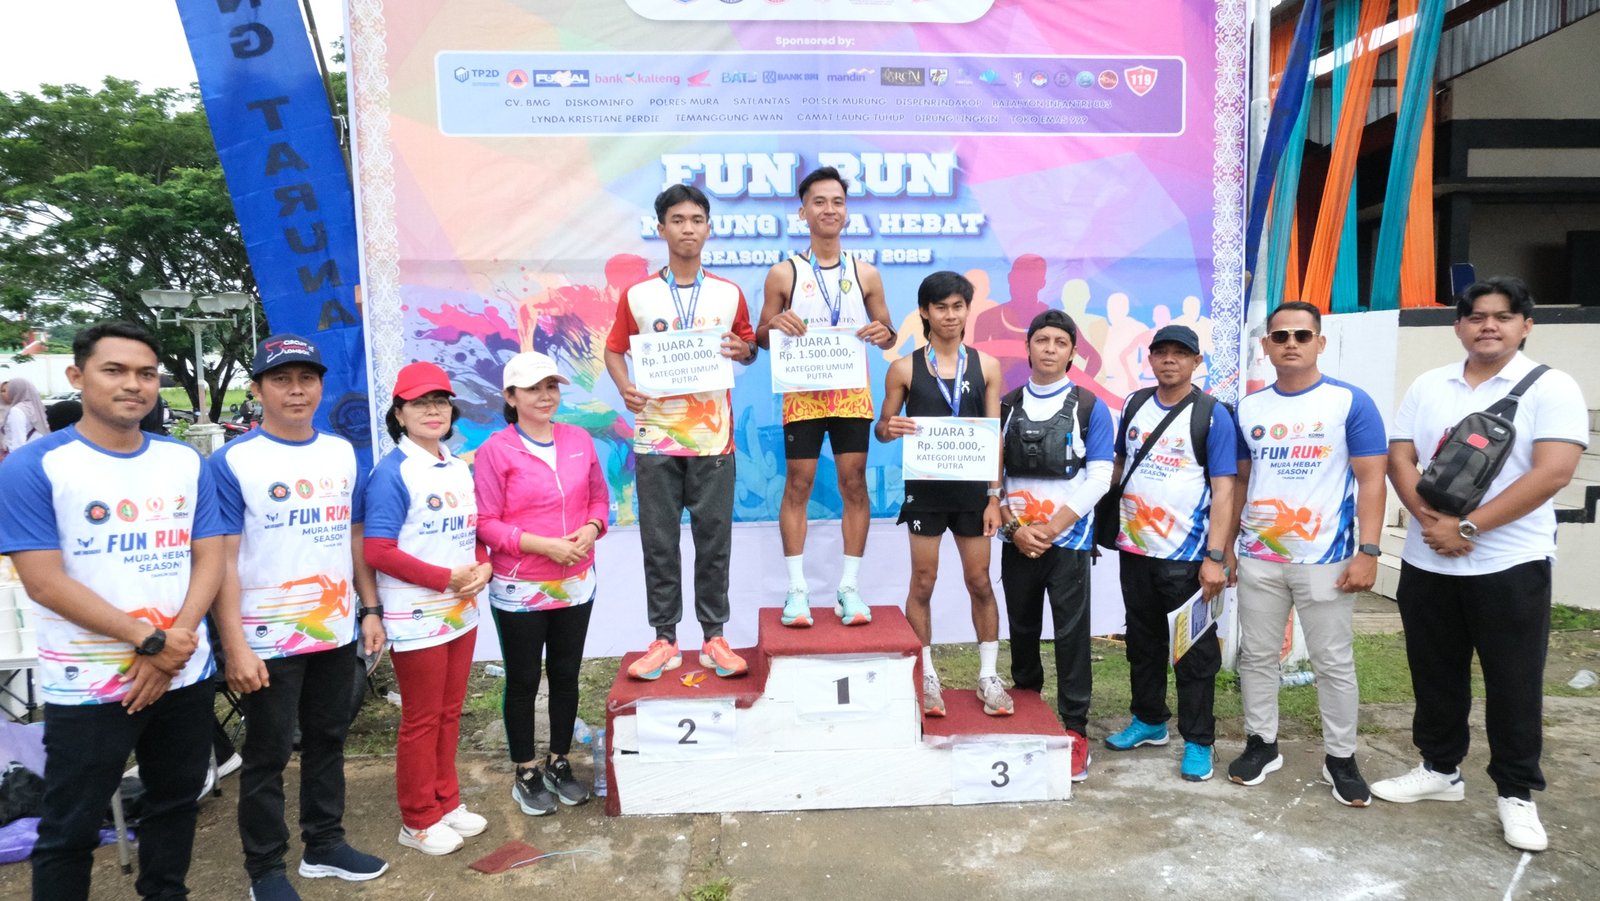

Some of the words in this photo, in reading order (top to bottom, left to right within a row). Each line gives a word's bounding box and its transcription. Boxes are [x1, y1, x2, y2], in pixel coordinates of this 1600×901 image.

[775, 36, 835, 47] Sponsored
[837, 36, 855, 47] by:
[471, 69, 500, 78] TP2D
[535, 73, 589, 82] FUAL
[595, 73, 623, 83] bank
[637, 73, 681, 85] kalteng
[777, 73, 803, 81] BANK
[1131, 74, 1152, 86] 119
[504, 98, 523, 107] CV.
[526, 98, 551, 107] BMG
[565, 98, 634, 107] DISKOMINFO
[650, 98, 687, 106] POLRES
[690, 97, 720, 105] MURA
[733, 97, 791, 105] SATLANTAS
[802, 97, 839, 105] POLSEK
[842, 97, 887, 105] MURUNG
[531, 115, 565, 123] LYNDA
[568, 115, 623, 123] KRISTIANE
[625, 114, 660, 123] PERDIE
[675, 113, 749, 122] TEMANGGUNG
[752, 113, 783, 121] AWAN
[797, 113, 833, 121] CAMAT
[836, 113, 870, 121] LAUNG
[873, 113, 905, 121] TUHUP
[660, 152, 799, 197] FUN
[818, 152, 956, 196] RUN
[879, 213, 985, 236] HEBAT
[701, 249, 781, 265] SEASON
[881, 249, 933, 265] 2025
[657, 340, 694, 353] JUARA
[696, 337, 704, 348] 2
[795, 337, 832, 348] JUARA
[835, 336, 841, 346] 1
[641, 356, 659, 368] Rp.
[662, 349, 720, 364] 1.000.000,-
[779, 350, 796, 362] Rp.
[799, 348, 856, 361] 1.500.000,-
[649, 366, 689, 379] KATEGORI
[690, 363, 719, 374] UMUM
[785, 363, 823, 374] KATEGORI
[825, 362, 854, 371] UMUM
[671, 374, 699, 385] PUTRA
[806, 371, 833, 380] PUTRA
[928, 426, 966, 437] JUARA
[968, 426, 974, 437] 3
[917, 441, 934, 452] Rp.
[937, 441, 985, 452] 500.000,-
[1260, 446, 1290, 460] FUN
[1291, 445, 1323, 459] RUN
[916, 454, 956, 462] KATEGORI
[957, 454, 986, 462] UMUM
[937, 462, 964, 470] PUTRA
[1140, 468, 1167, 479] SEASON
[288, 507, 321, 527] FUN
[302, 526, 329, 536] MURA
[331, 524, 347, 532] HEBA
[441, 515, 464, 533] FUN
[106, 532, 147, 553] FUN
[155, 528, 190, 549] RUN
[123, 553, 159, 564] MURA
[162, 549, 191, 560] HEBAT
[138, 561, 180, 573] SEASON
[832, 675, 850, 705] 1
[677, 718, 698, 745] 2
[990, 761, 1010, 788] 3
